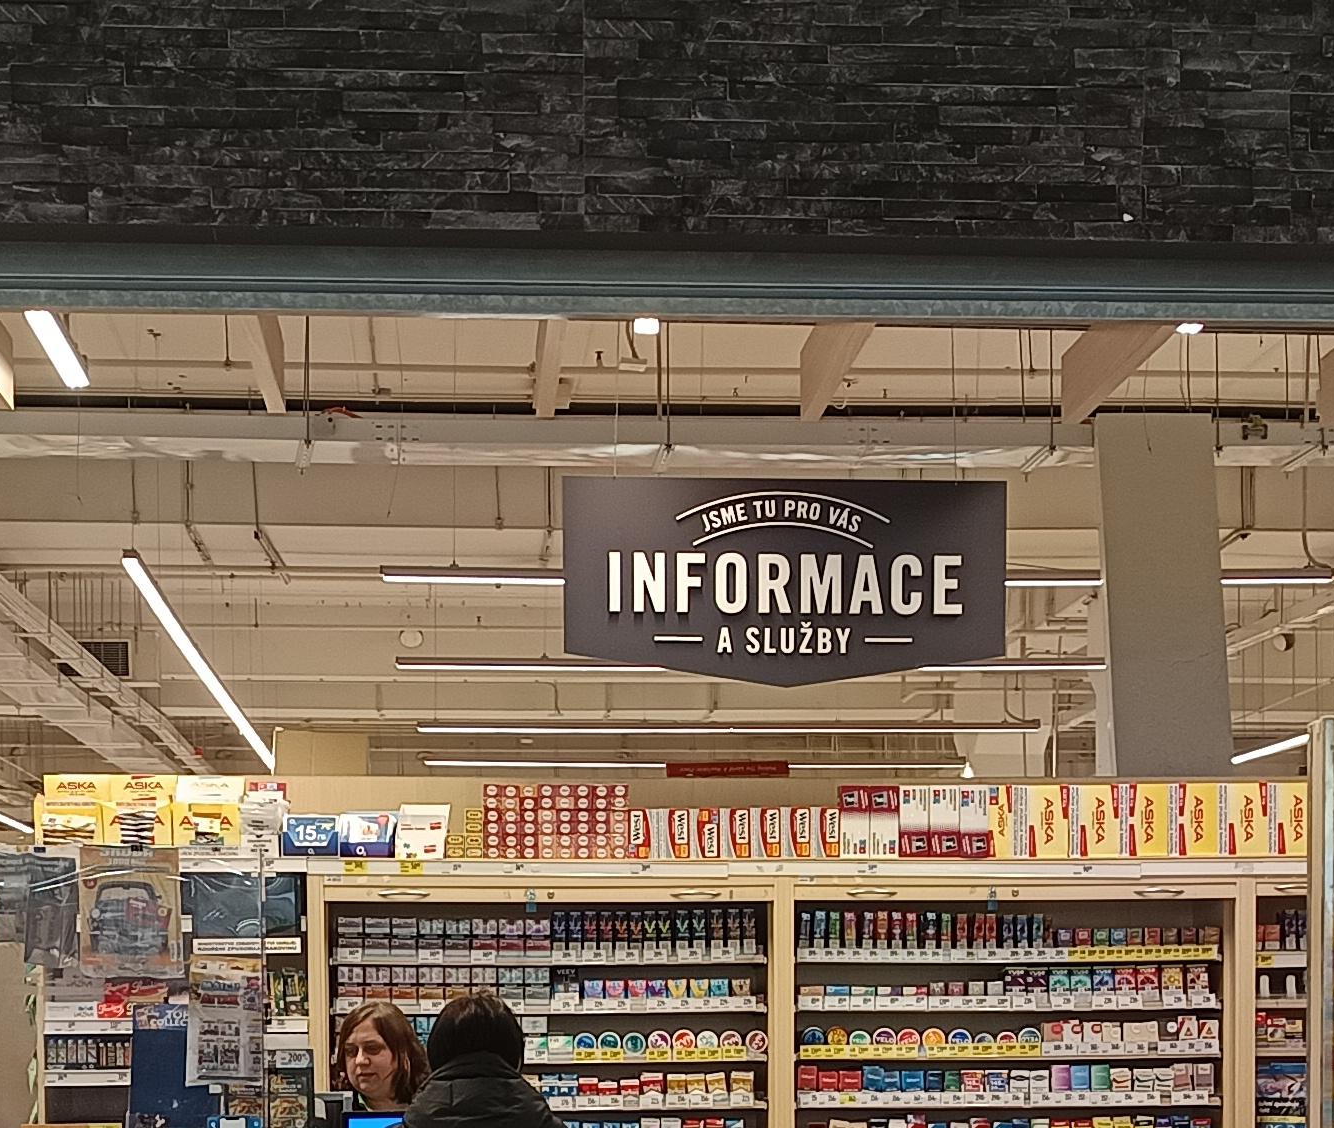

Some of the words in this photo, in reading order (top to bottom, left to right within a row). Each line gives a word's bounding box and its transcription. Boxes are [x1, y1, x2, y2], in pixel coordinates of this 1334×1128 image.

[701, 506, 748, 533] JSME
[753, 499, 776, 519] TU
[783, 499, 821, 521] PRO
[828, 507, 862, 533] VÁS
[607, 551, 964, 616] INFORMACE
[717, 627, 733, 654] A
[745, 621, 852, 655] SLUŽBY
[56, 781, 96, 791] ASKA
[123, 781, 164, 791] ASKA
[631, 811, 644, 843] West
[677, 811, 689, 841] West
[738, 811, 749, 842] West
[769, 811, 780, 842] West
[797, 811, 809, 842] West
[827, 810, 838, 842] West
[1043, 796, 1056, 846] ASKA
[1095, 796, 1107, 845] ASKA
[1143, 796, 1156, 846] ASKA
[1193, 795, 1205, 845] ASKA
[1243, 795, 1254, 844] ASKA
[1293, 794, 1305, 844] ASKA
[705, 825, 717, 855] West
